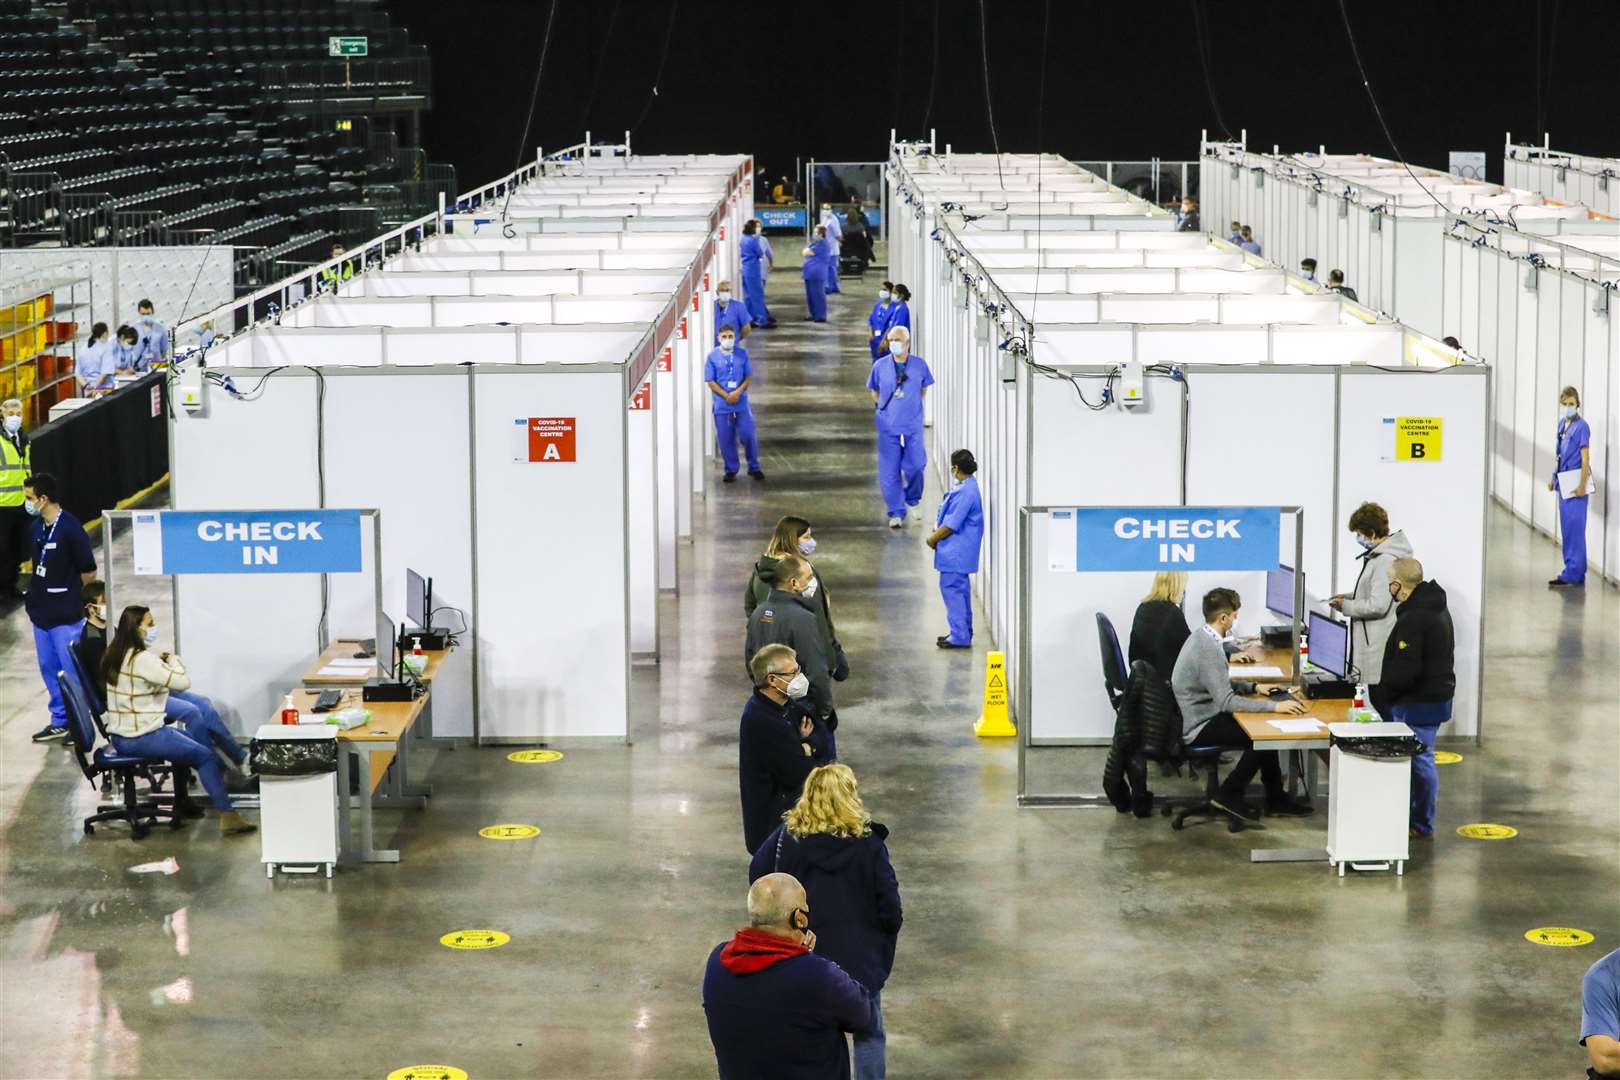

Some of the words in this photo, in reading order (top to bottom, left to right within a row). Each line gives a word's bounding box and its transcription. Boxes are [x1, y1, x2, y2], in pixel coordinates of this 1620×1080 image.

[543, 443, 561, 460] A
[1411, 443, 1426, 458] B
[197, 520, 323, 541] CHECK
[1113, 517, 1242, 539] CHECK
[242, 546, 278, 565] IN
[1159, 543, 1195, 562] IN
